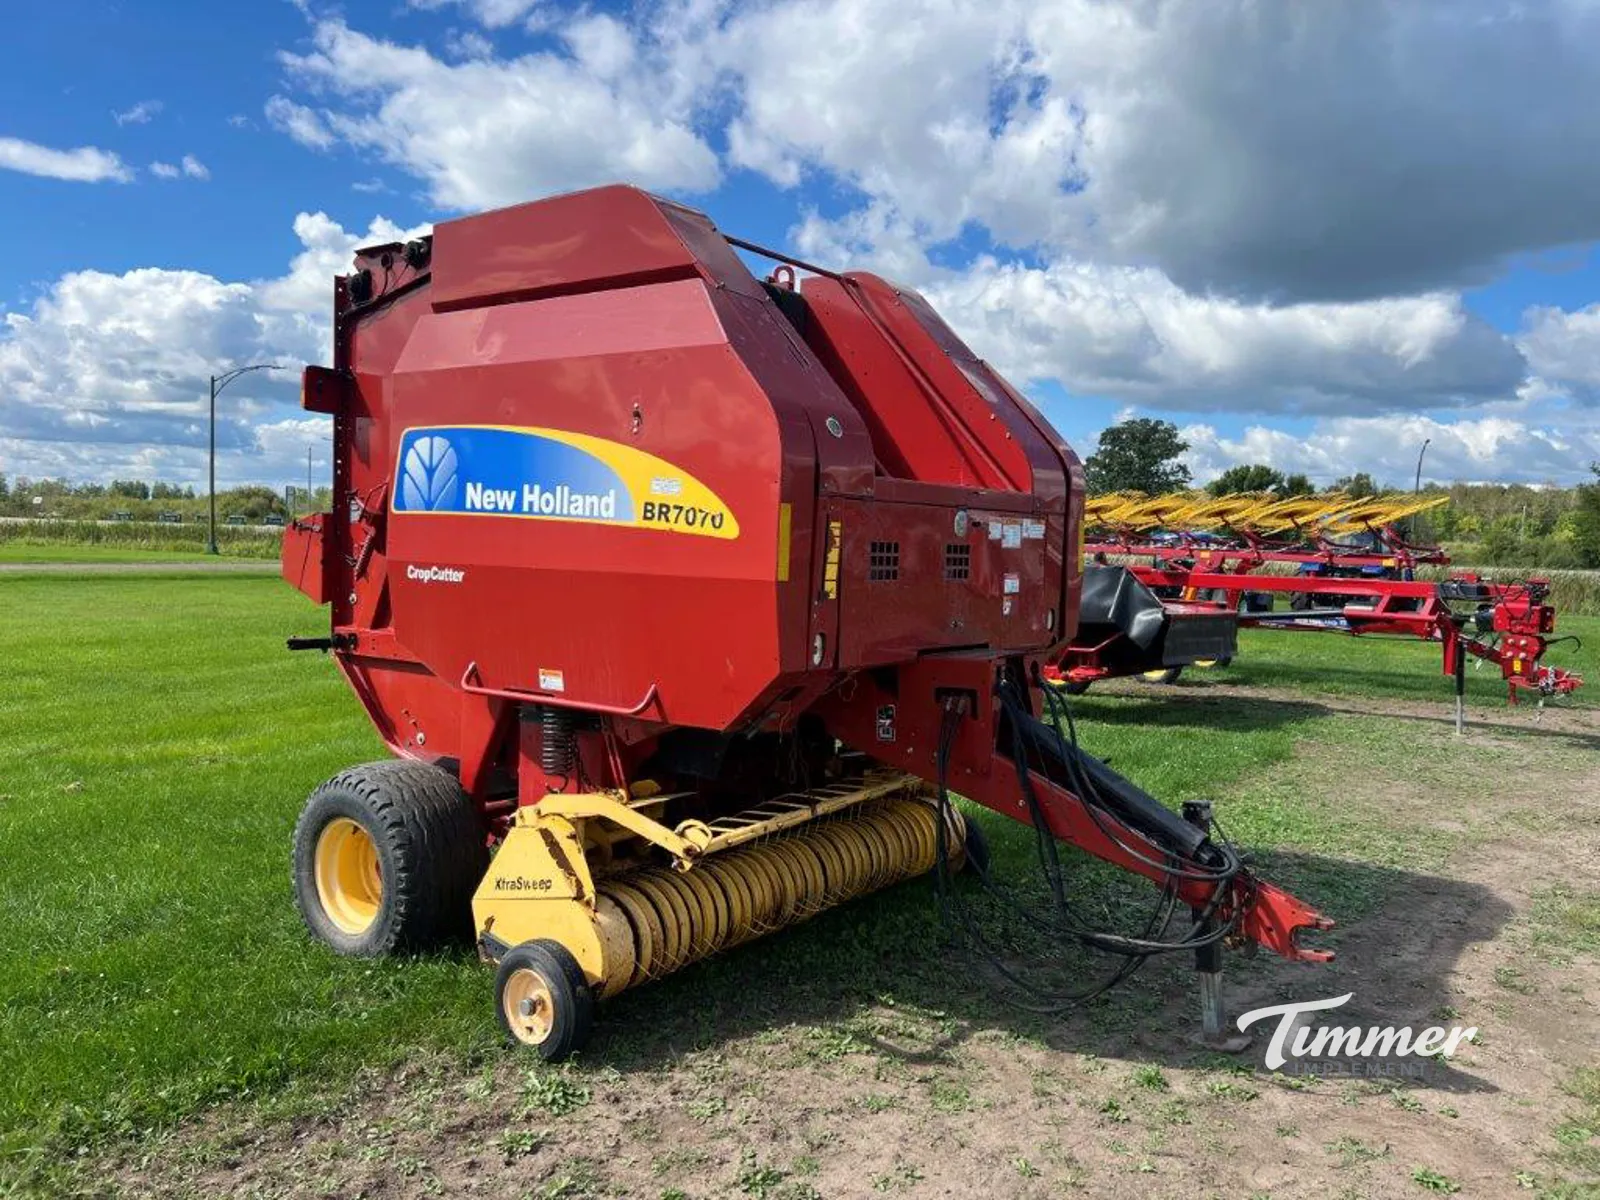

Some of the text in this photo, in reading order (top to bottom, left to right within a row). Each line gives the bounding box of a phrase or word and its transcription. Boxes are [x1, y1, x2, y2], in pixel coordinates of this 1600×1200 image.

[465, 482, 516, 511] New
[522, 484, 616, 518] Holland
[643, 501, 724, 529] BR7070
[407, 564, 465, 583] CropCutter
[494, 876, 552, 892] XtraSweep
